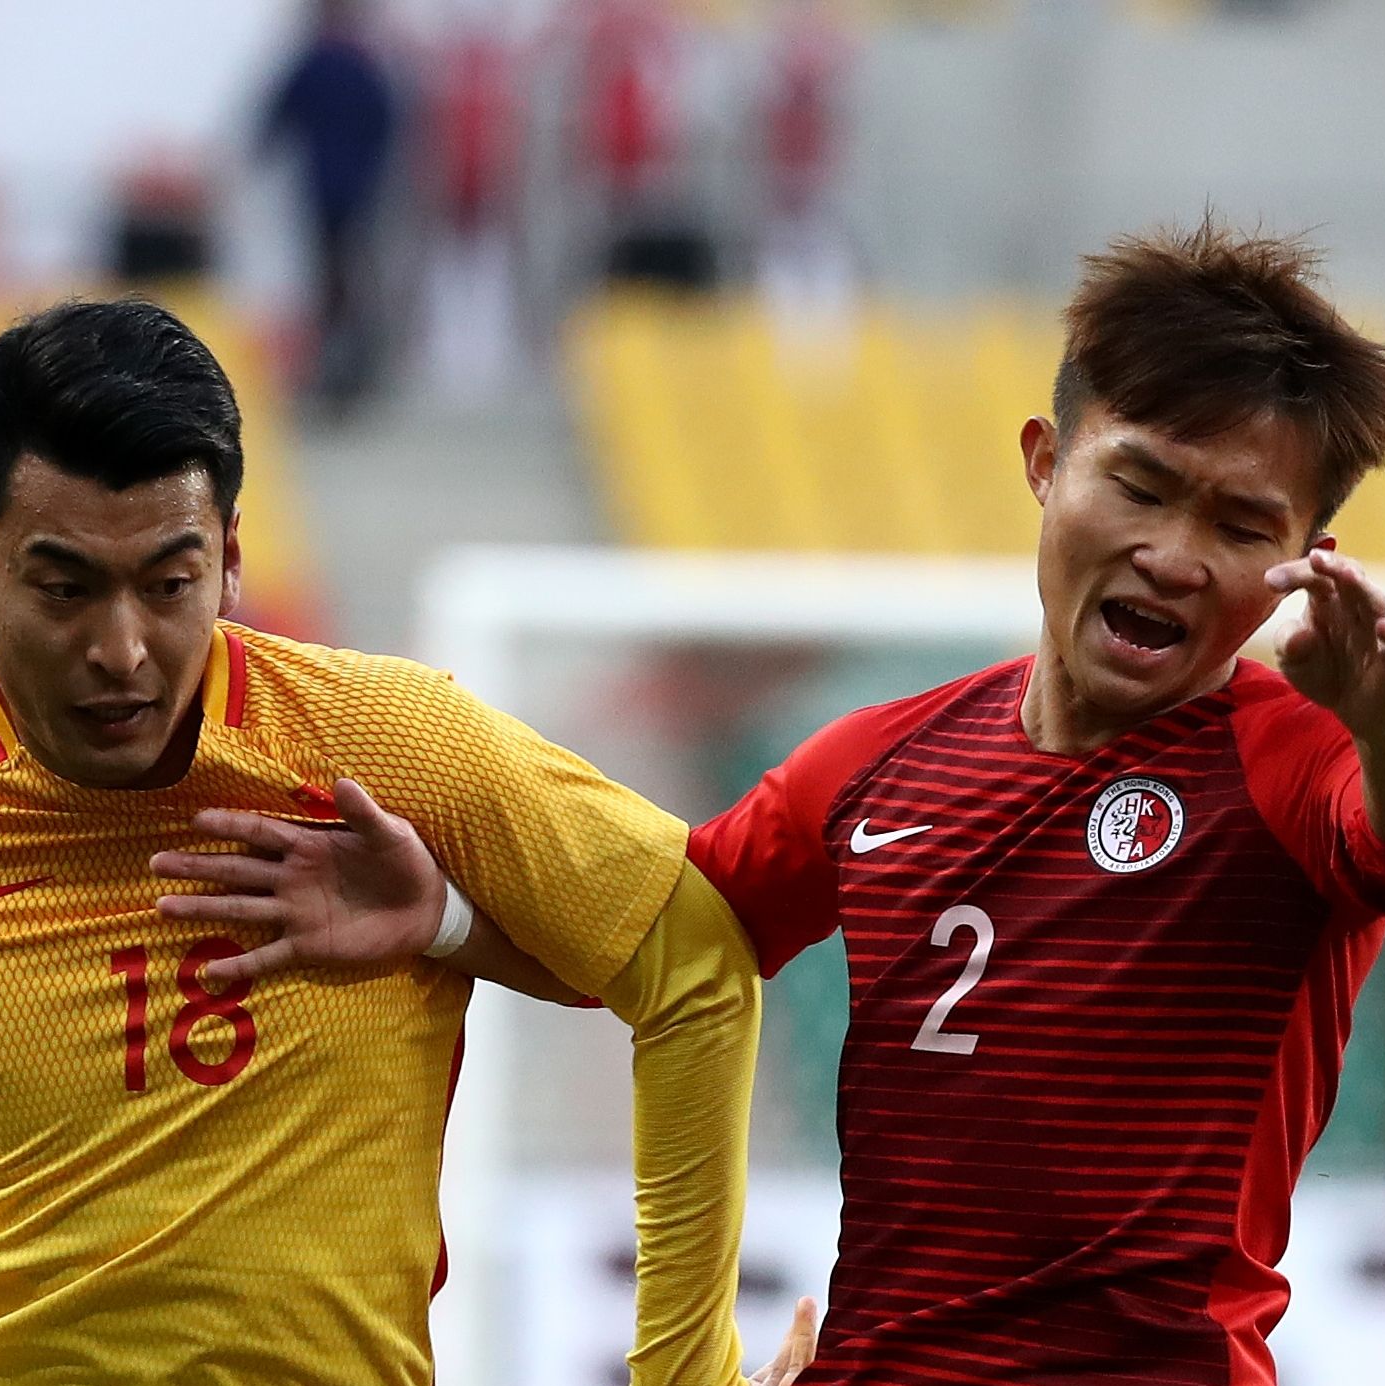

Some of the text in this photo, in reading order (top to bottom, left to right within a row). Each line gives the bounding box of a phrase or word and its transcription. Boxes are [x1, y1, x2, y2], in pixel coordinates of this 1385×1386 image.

[1105, 779, 1176, 803] THE HONG KONG
[1123, 797, 1156, 816] HK
[1089, 817, 1107, 865] FOOTBALL
[1108, 844, 1171, 870] ASSOCIATION
[1116, 841, 1144, 858] FA
[911, 904, 995, 1055] 2
[110, 937, 258, 1092] 18
